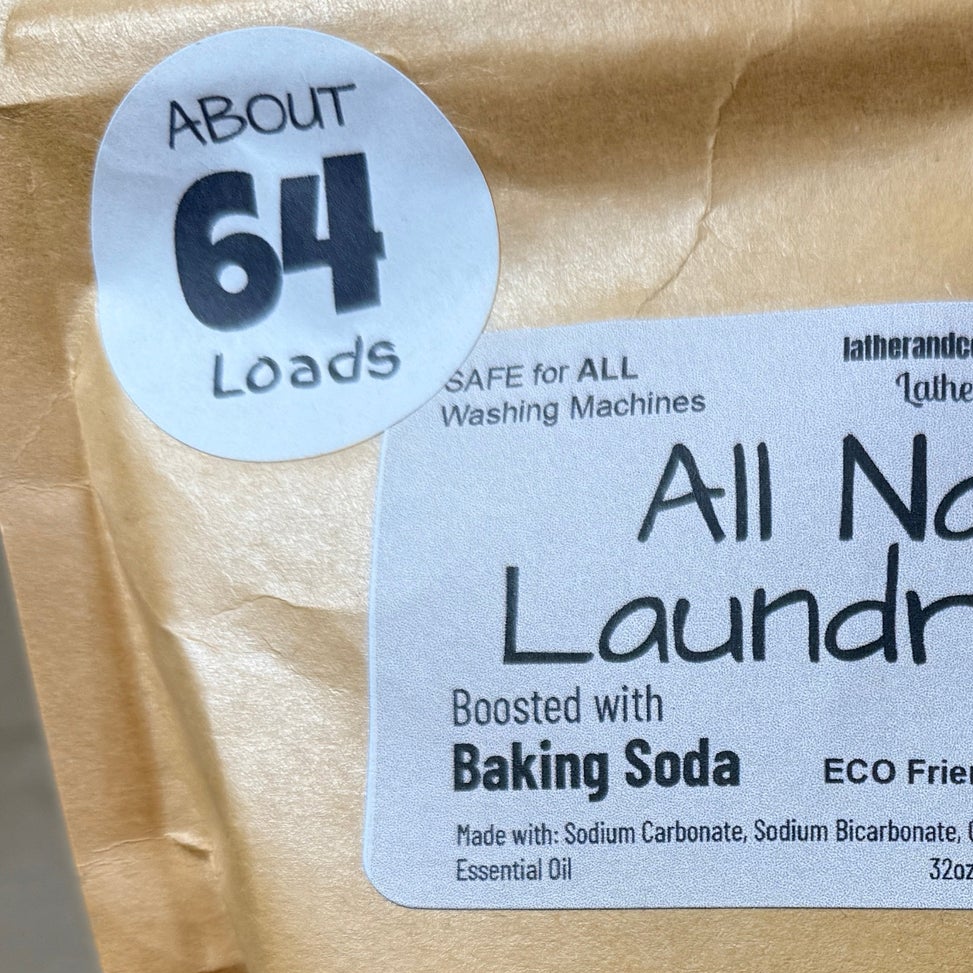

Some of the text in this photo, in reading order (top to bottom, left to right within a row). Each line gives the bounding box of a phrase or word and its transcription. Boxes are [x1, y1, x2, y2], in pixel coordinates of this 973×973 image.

[166, 83, 356, 149] ABOUT
[174, 152, 386, 331] 64
[212, 336, 400, 398] Loads
[445, 357, 638, 392] SAFE for ALL
[441, 392, 706, 426] Washing Machines
[637, 442, 771, 542] All
[452, 685, 664, 725] Boosted with
[453, 738, 740, 802] Baking Soda
[824, 758, 896, 785] ECO
[456, 823, 506, 846] Made
[511, 822, 558, 845] with:
[564, 820, 635, 845] Sodium
[641, 819, 748, 846] Carbonate,
[754, 819, 829, 843] Sodium
[836, 818, 959, 845] Bicarbonate,
[456, 858, 572, 881] Essential Oil
